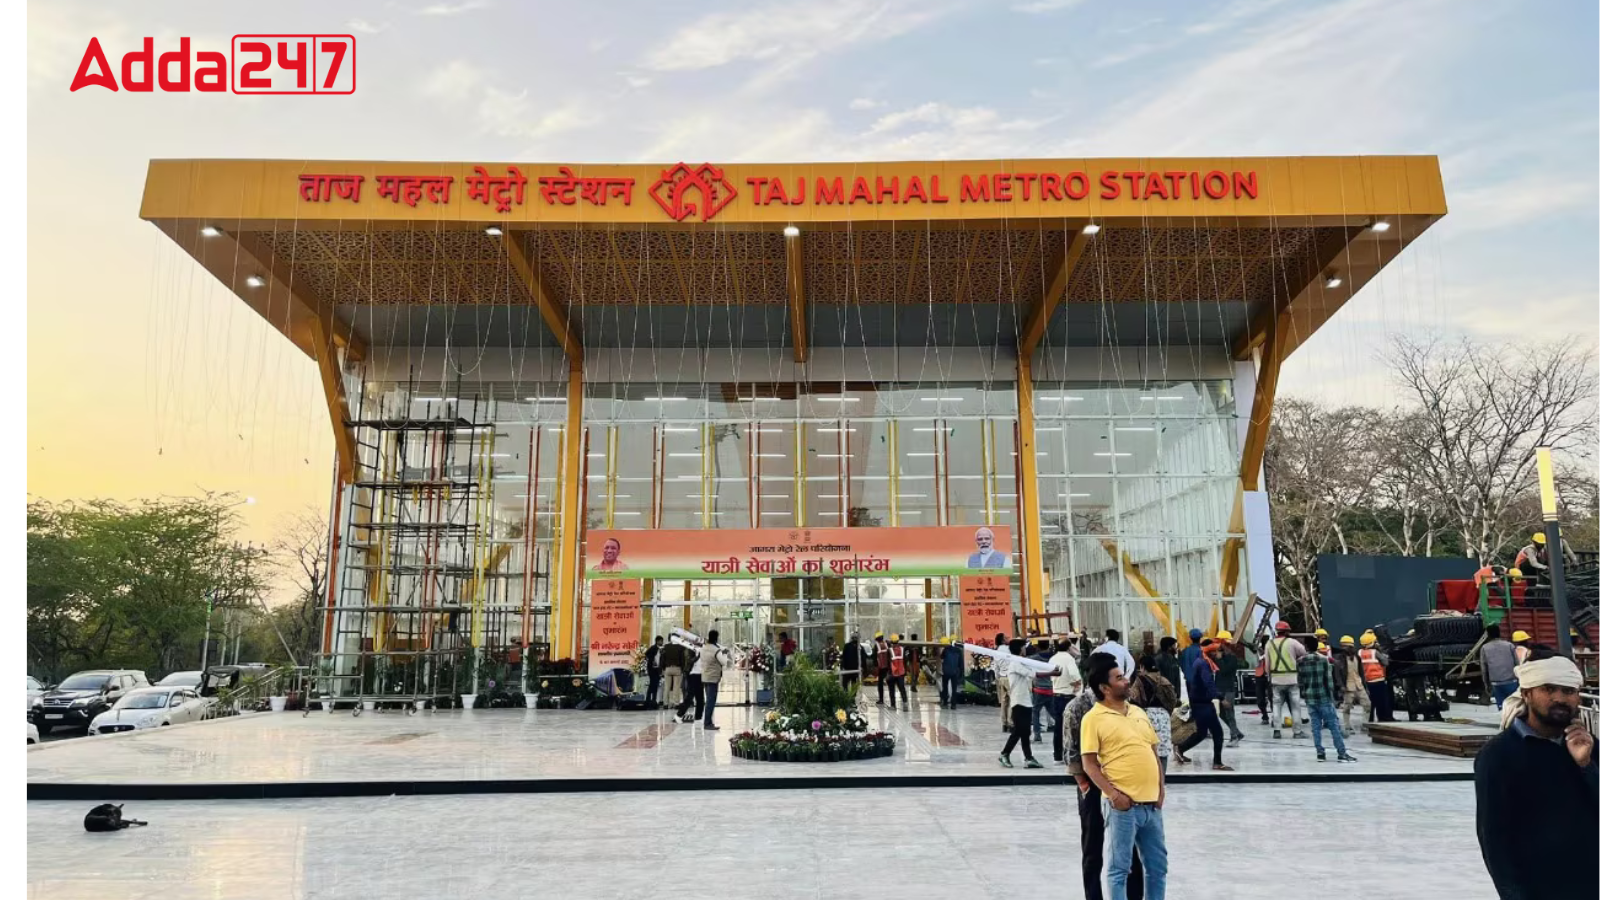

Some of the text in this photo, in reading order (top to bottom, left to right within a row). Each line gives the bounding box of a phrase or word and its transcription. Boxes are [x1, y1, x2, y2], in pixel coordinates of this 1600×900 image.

[298, 165, 637, 214] ताज महल मेट्रो स्टेशन
[746, 169, 1260, 206] TAJ MAHAL METRO STATION
[777, 544, 794, 554] मेट्रो
[795, 545, 809, 553] रेल
[701, 557, 740, 574] यात्री
[745, 556, 797, 574] सेवाओं
[829, 555, 890, 575] शुभारंभ
